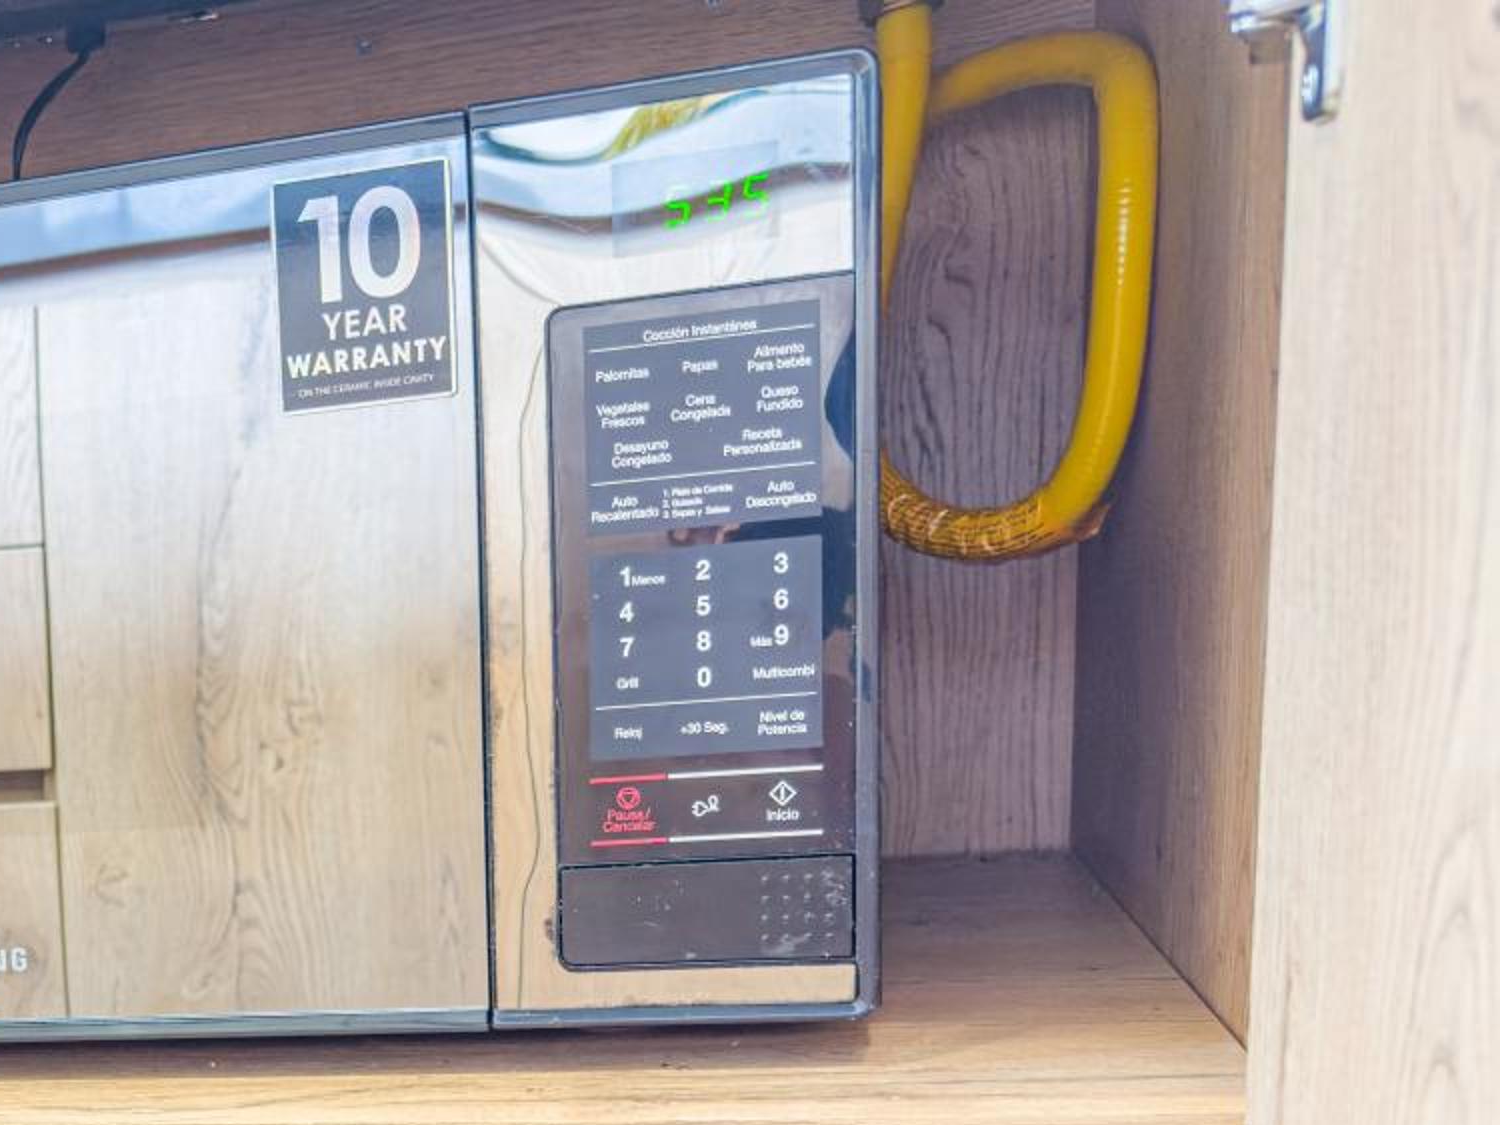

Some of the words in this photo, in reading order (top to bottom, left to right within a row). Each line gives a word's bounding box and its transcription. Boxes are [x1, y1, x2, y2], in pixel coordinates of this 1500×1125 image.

[297, 185, 420, 304] 10
[322, 304, 407, 341] YEAR
[643, 323, 689, 343] Cocción
[287, 335, 447, 379] WARRANTY
[754, 342, 805, 358] Alimento
[682, 360, 718, 374] Papas
[747, 358, 775, 372] Para
[595, 367, 650, 383] Palomitas
[761, 384, 799, 399] Queso
[685, 393, 716, 407] Cena
[756, 397, 804, 412] Fundido
[596, 401, 650, 417] Vegetales
[671, 405, 731, 423] Congelada
[601, 415, 645, 429] Frescos
[742, 427, 783, 441] Receta
[614, 439, 669, 456] Desayuno
[724, 439, 803, 457] Personalizada
[612, 452, 672, 469] Congelado
[768, 481, 794, 493] Auto
[612, 496, 638, 508] Auto
[746, 492, 817, 509] Descongelado
[591, 507, 659, 523] Recalentado
[695, 559, 711, 581] 2
[773, 552, 789, 574] 3
[620, 566, 631, 587] 1
[632, 573, 665, 586] Menos
[696, 596, 711, 616] 5
[773, 589, 789, 610] 6
[619, 602, 634, 622] 4
[696, 631, 711, 652] 8
[774, 624, 789, 646] 9
[619, 637, 635, 657] 7
[697, 667, 711, 688] 0
[753, 664, 815, 680] Multicombi
[616, 677, 639, 690] Grill
[760, 710, 788, 724] Nivel
[790, 710, 805, 722] de
[614, 727, 642, 741] Reloj
[757, 722, 807, 736] Potencia
[602, 819, 657, 833] Cancelar
